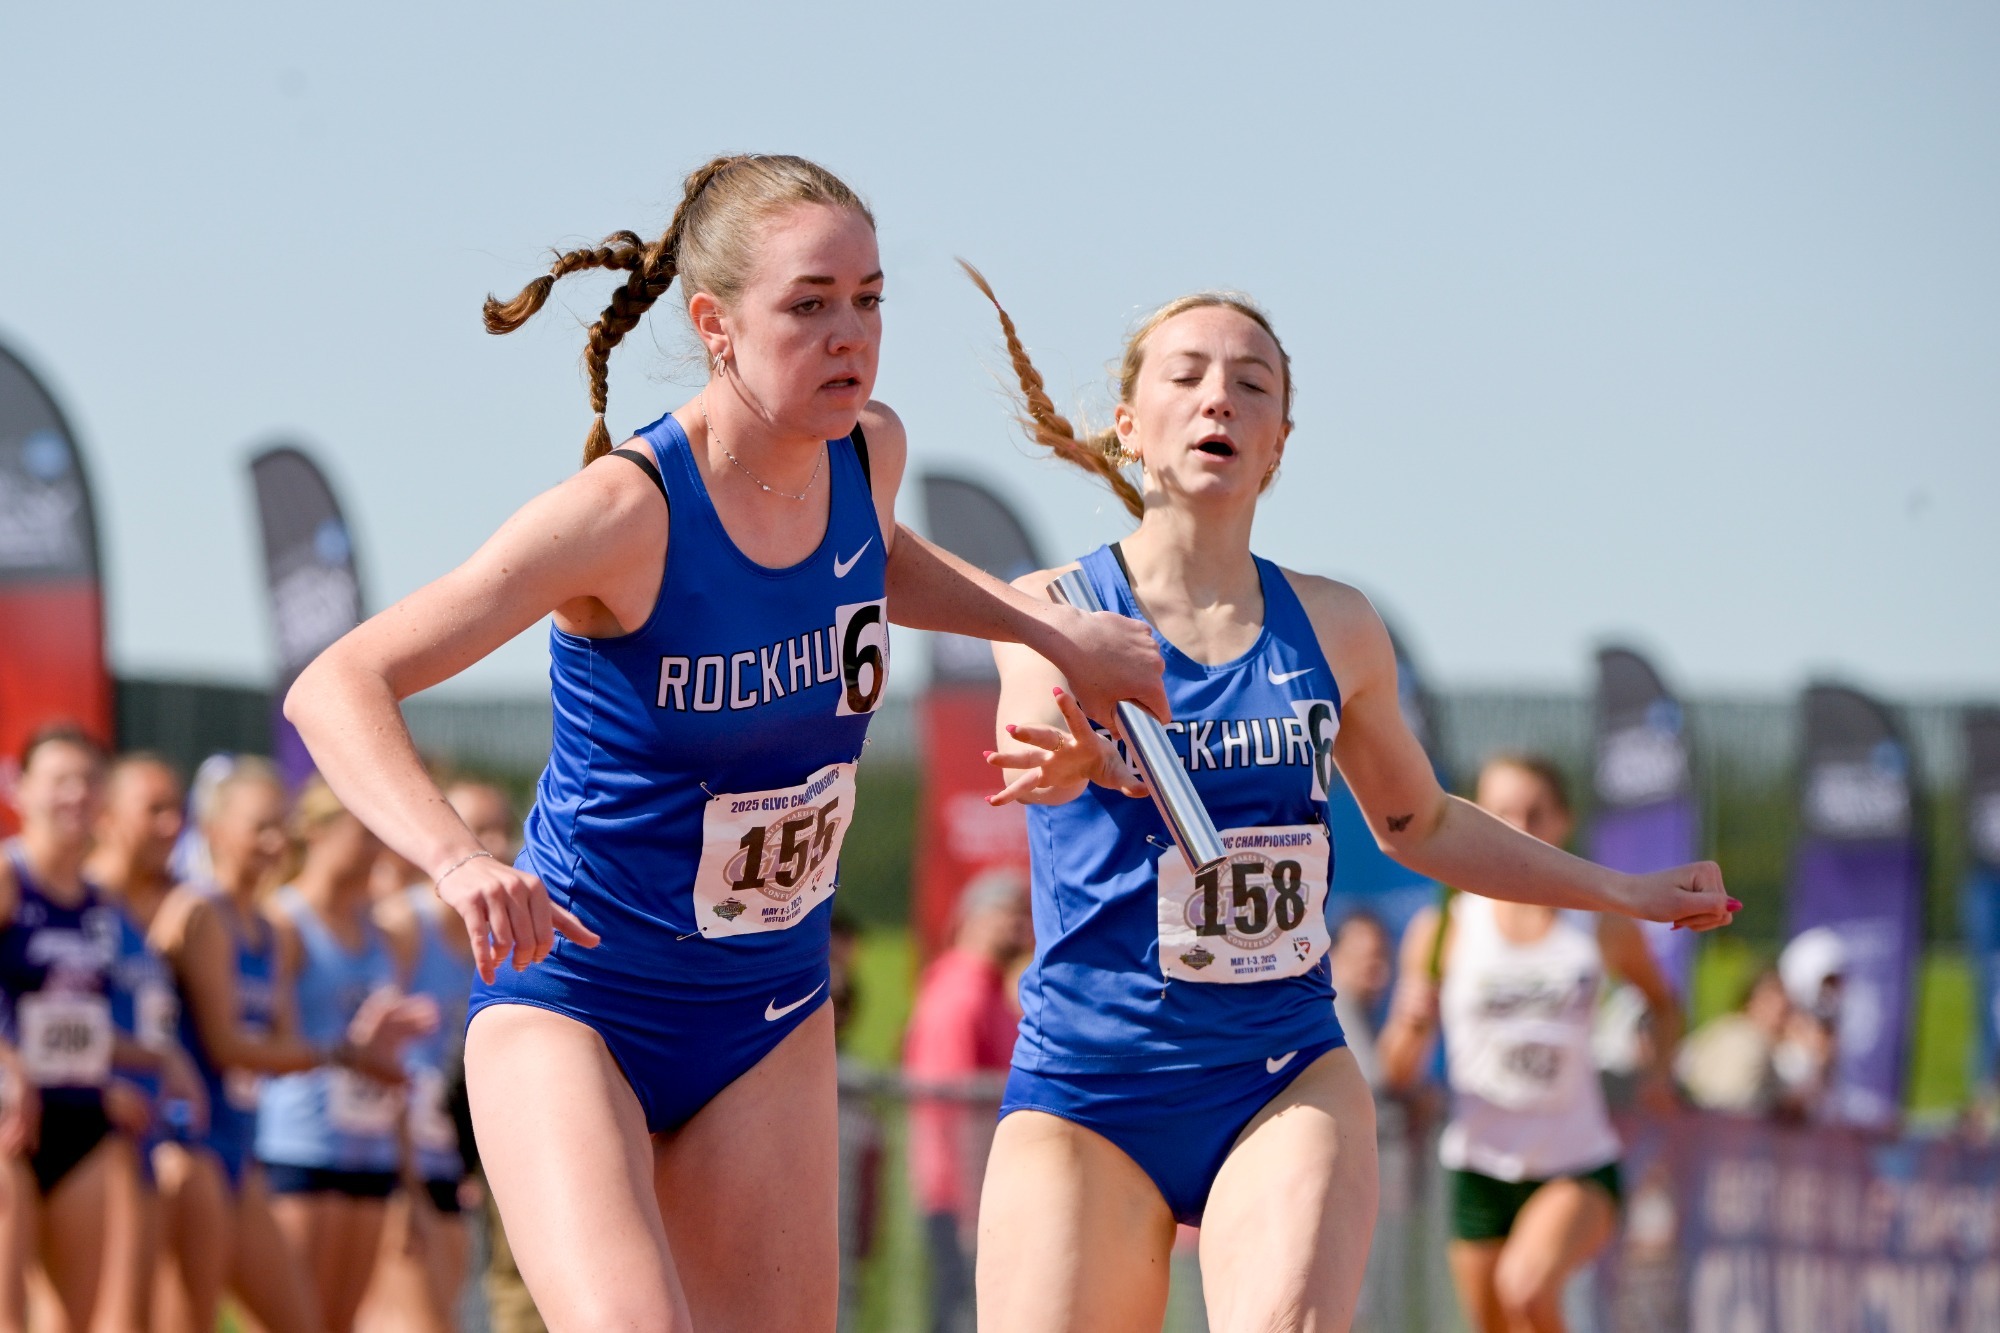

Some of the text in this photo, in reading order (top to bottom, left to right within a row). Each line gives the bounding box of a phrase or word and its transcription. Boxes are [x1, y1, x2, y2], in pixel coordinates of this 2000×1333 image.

[656, 624, 839, 712] ROCKHU
[843, 605, 883, 713] 6
[731, 799, 759, 813] 2025
[762, 796, 788, 811] GLVC
[732, 796, 839, 891] 155
[1235, 832, 1312, 849] CHAMPIONSHIPS
[761, 907, 779, 916] MAY
[1195, 860, 1305, 936] 158
[1231, 957, 1244, 966] MAY
